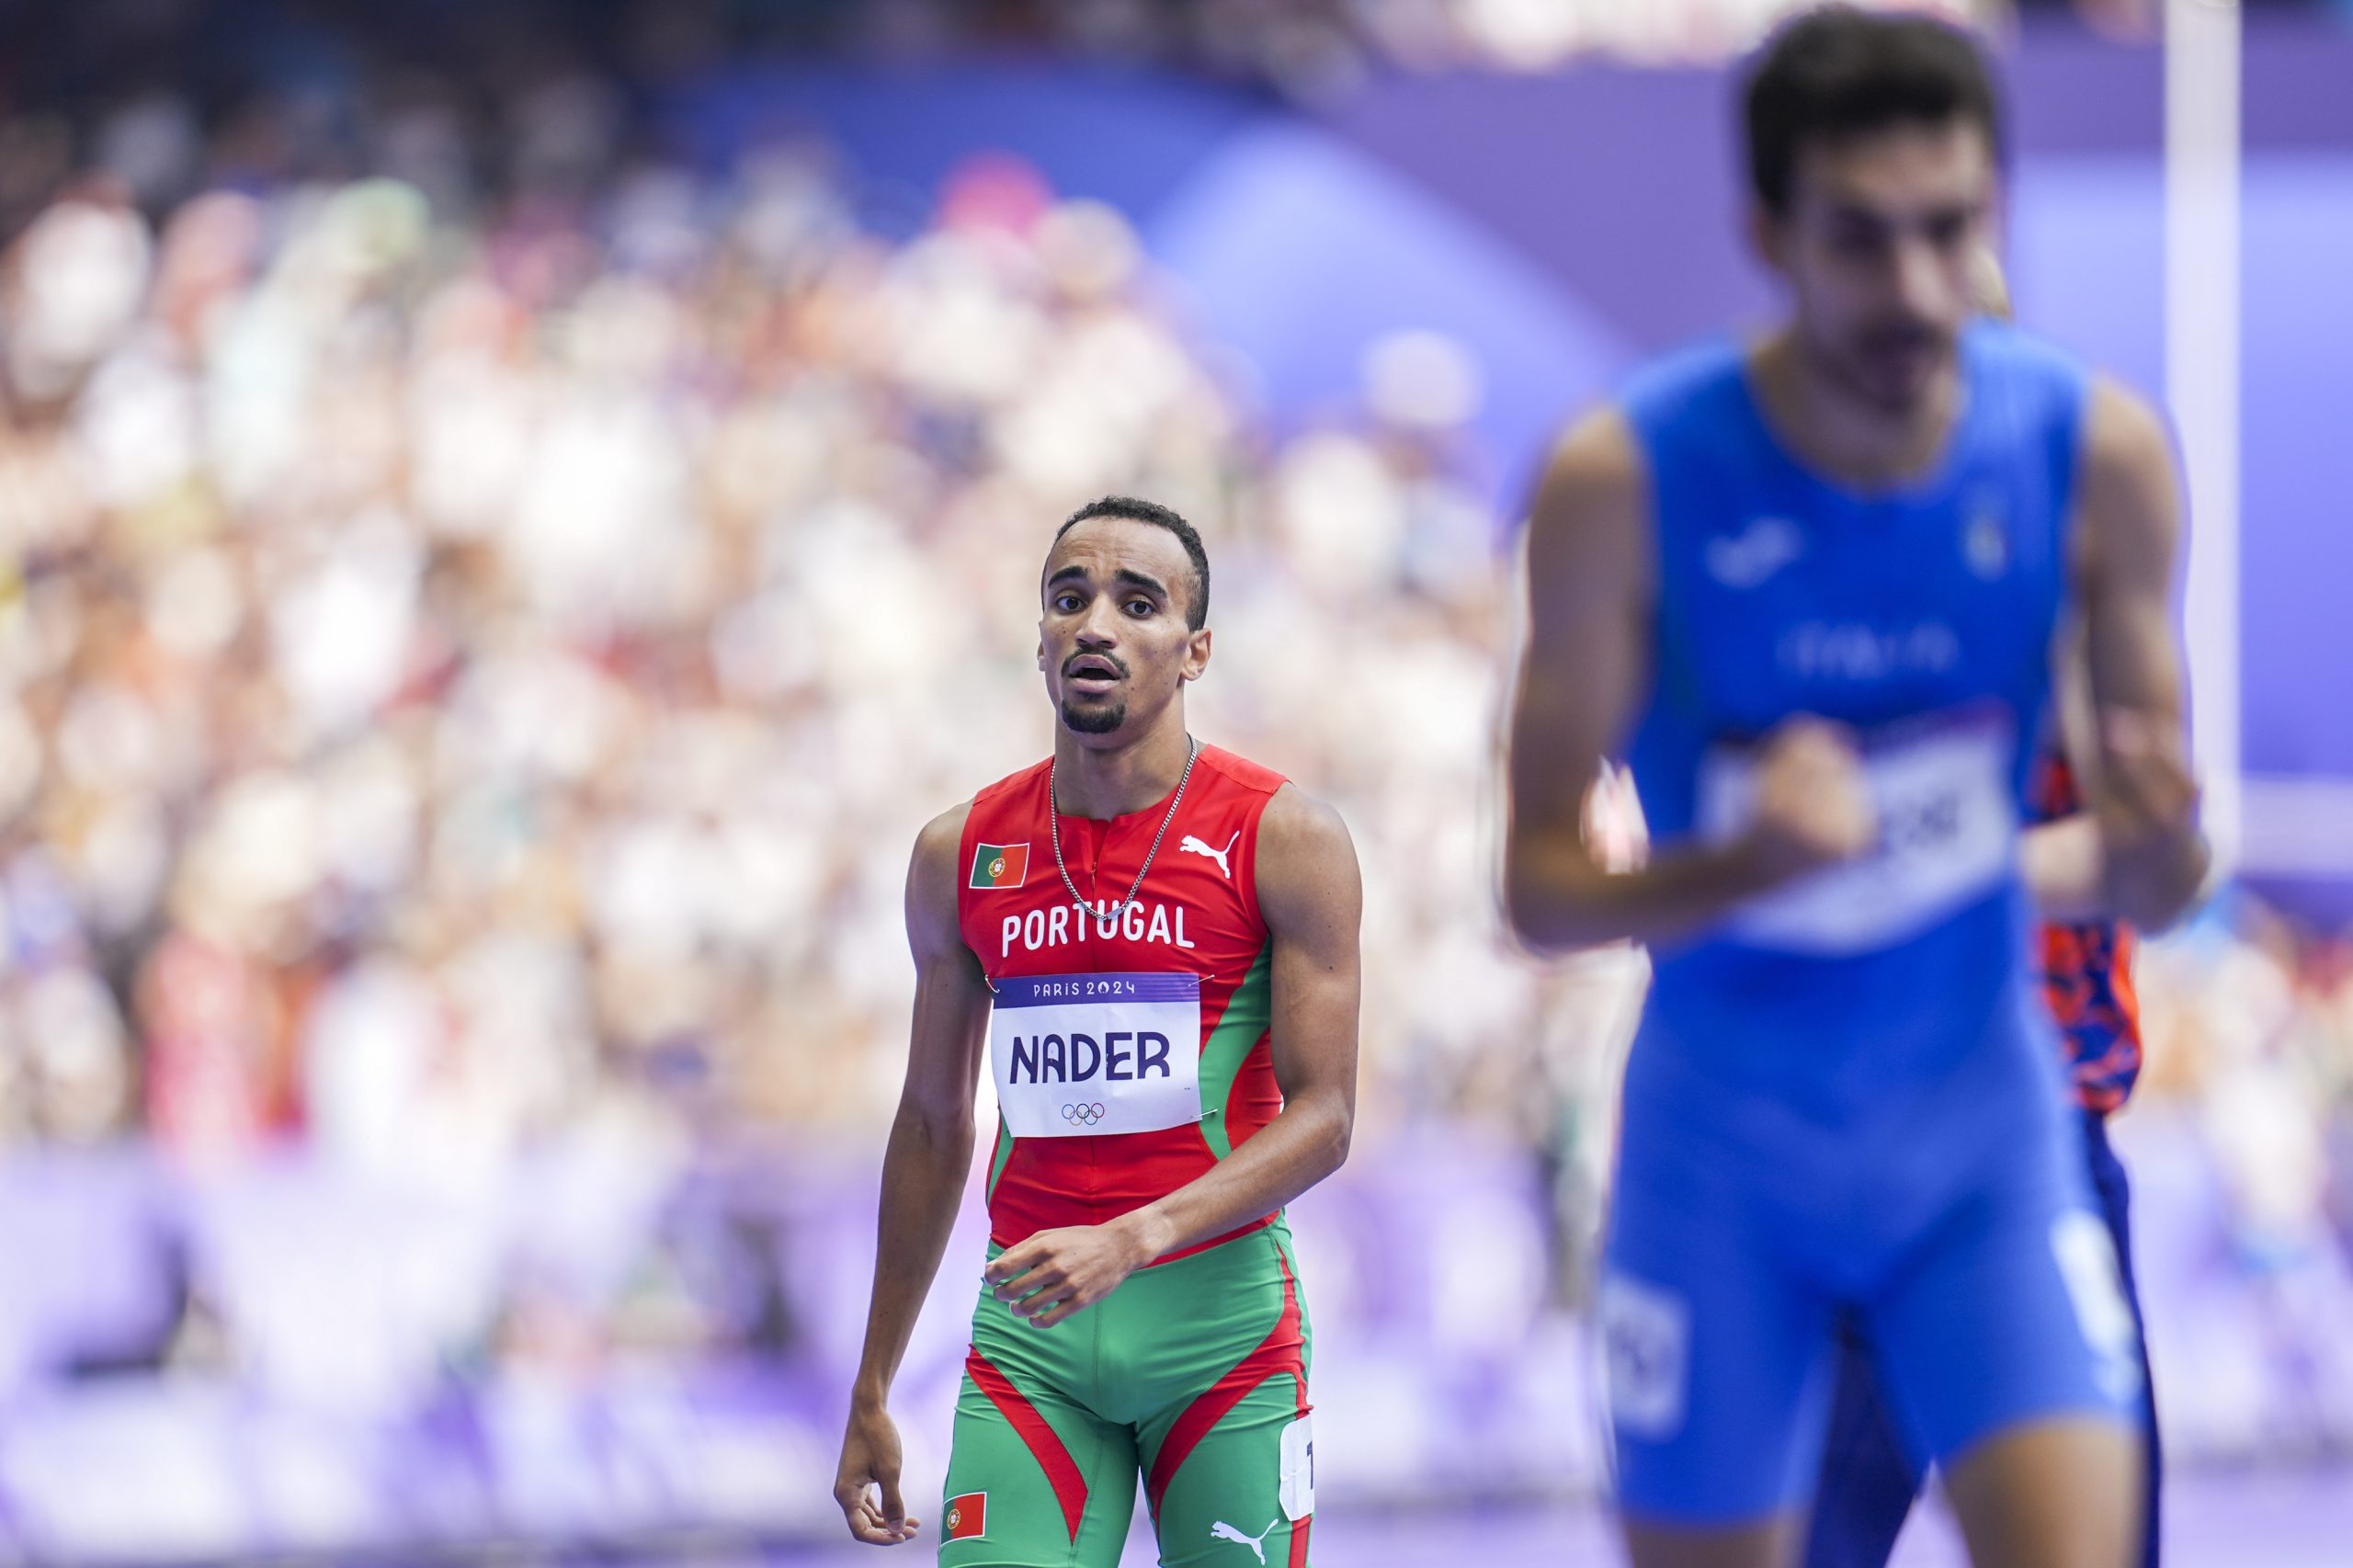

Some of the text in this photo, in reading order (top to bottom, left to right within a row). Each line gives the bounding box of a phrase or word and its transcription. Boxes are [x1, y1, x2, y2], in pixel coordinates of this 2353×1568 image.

[1002, 899, 1195, 958] PORTUGAL
[1086, 981, 1135, 995] 2024
[1009, 1031, 1170, 1085] NADER
